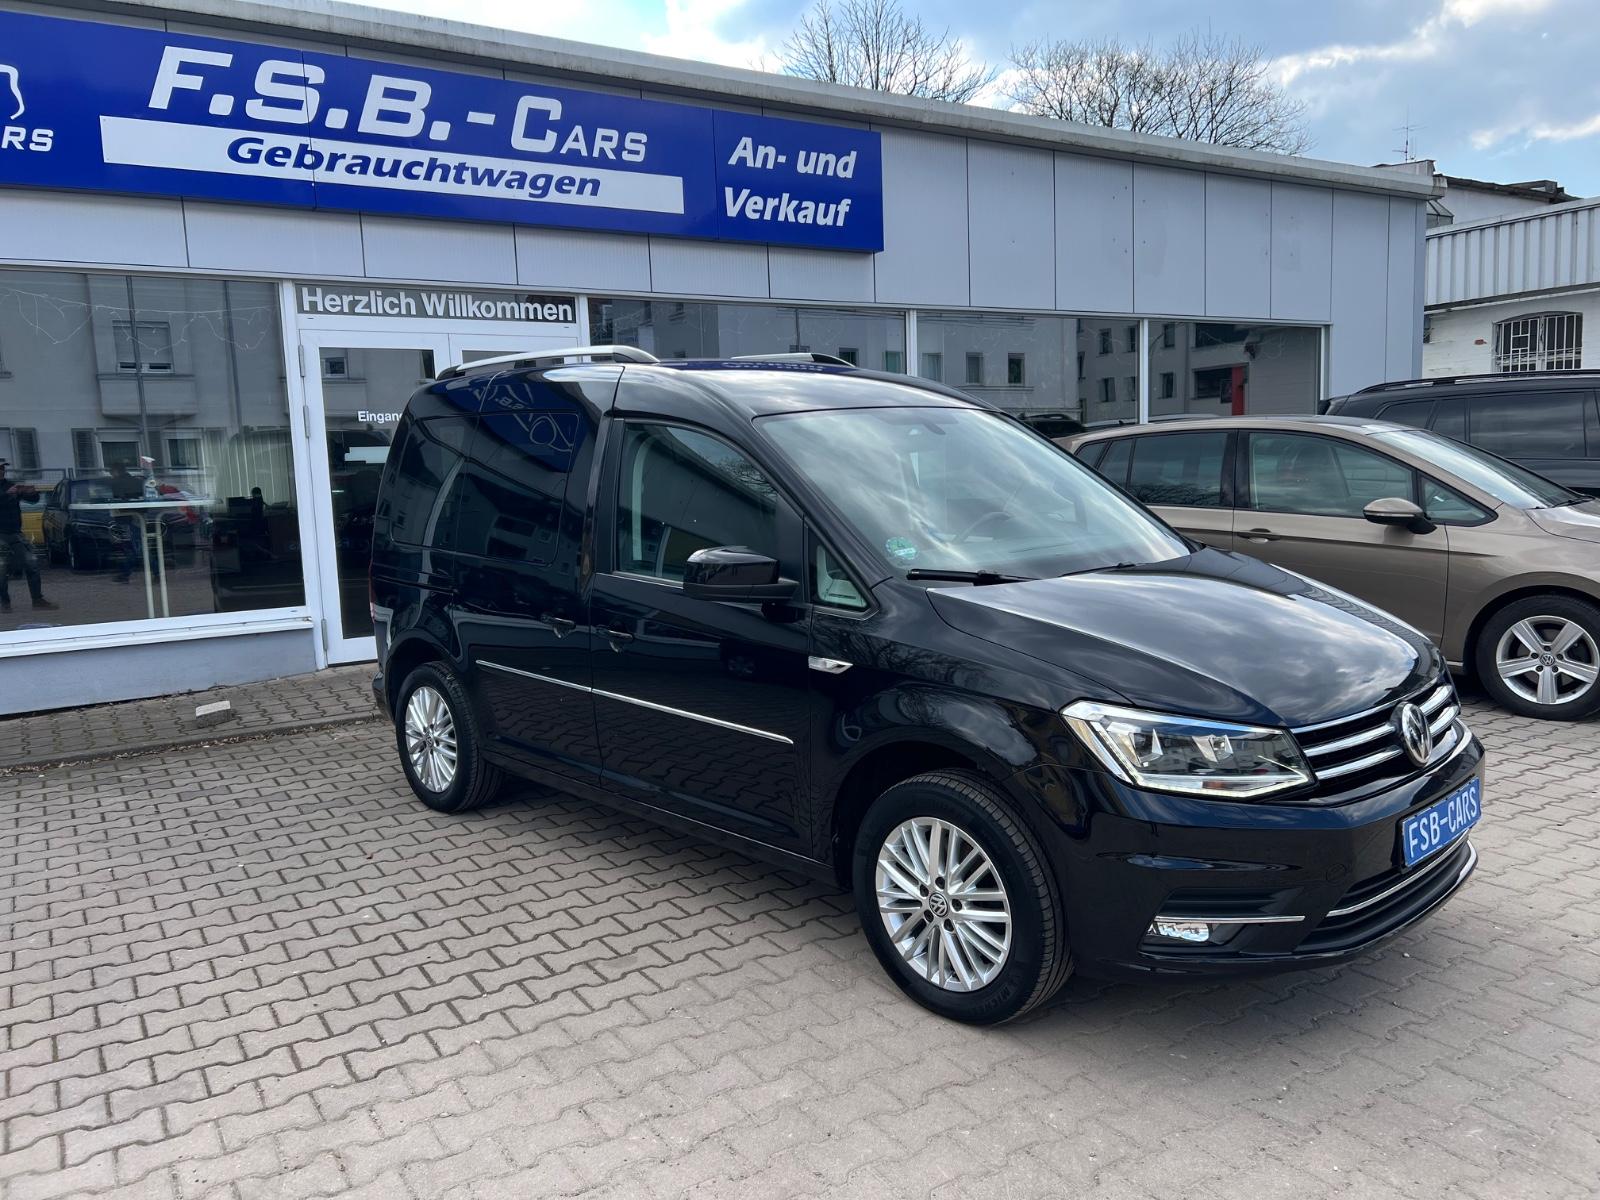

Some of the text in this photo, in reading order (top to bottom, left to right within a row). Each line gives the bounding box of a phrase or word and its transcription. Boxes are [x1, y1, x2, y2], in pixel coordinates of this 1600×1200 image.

[226, 136, 602, 199] Gebrauchtwagen
[727, 136, 857, 179] An- und
[724, 186, 852, 227] Verkauf
[301, 286, 573, 321] Herzlich Willkommen
[1408, 786, 1477, 858] FSB-CARS
